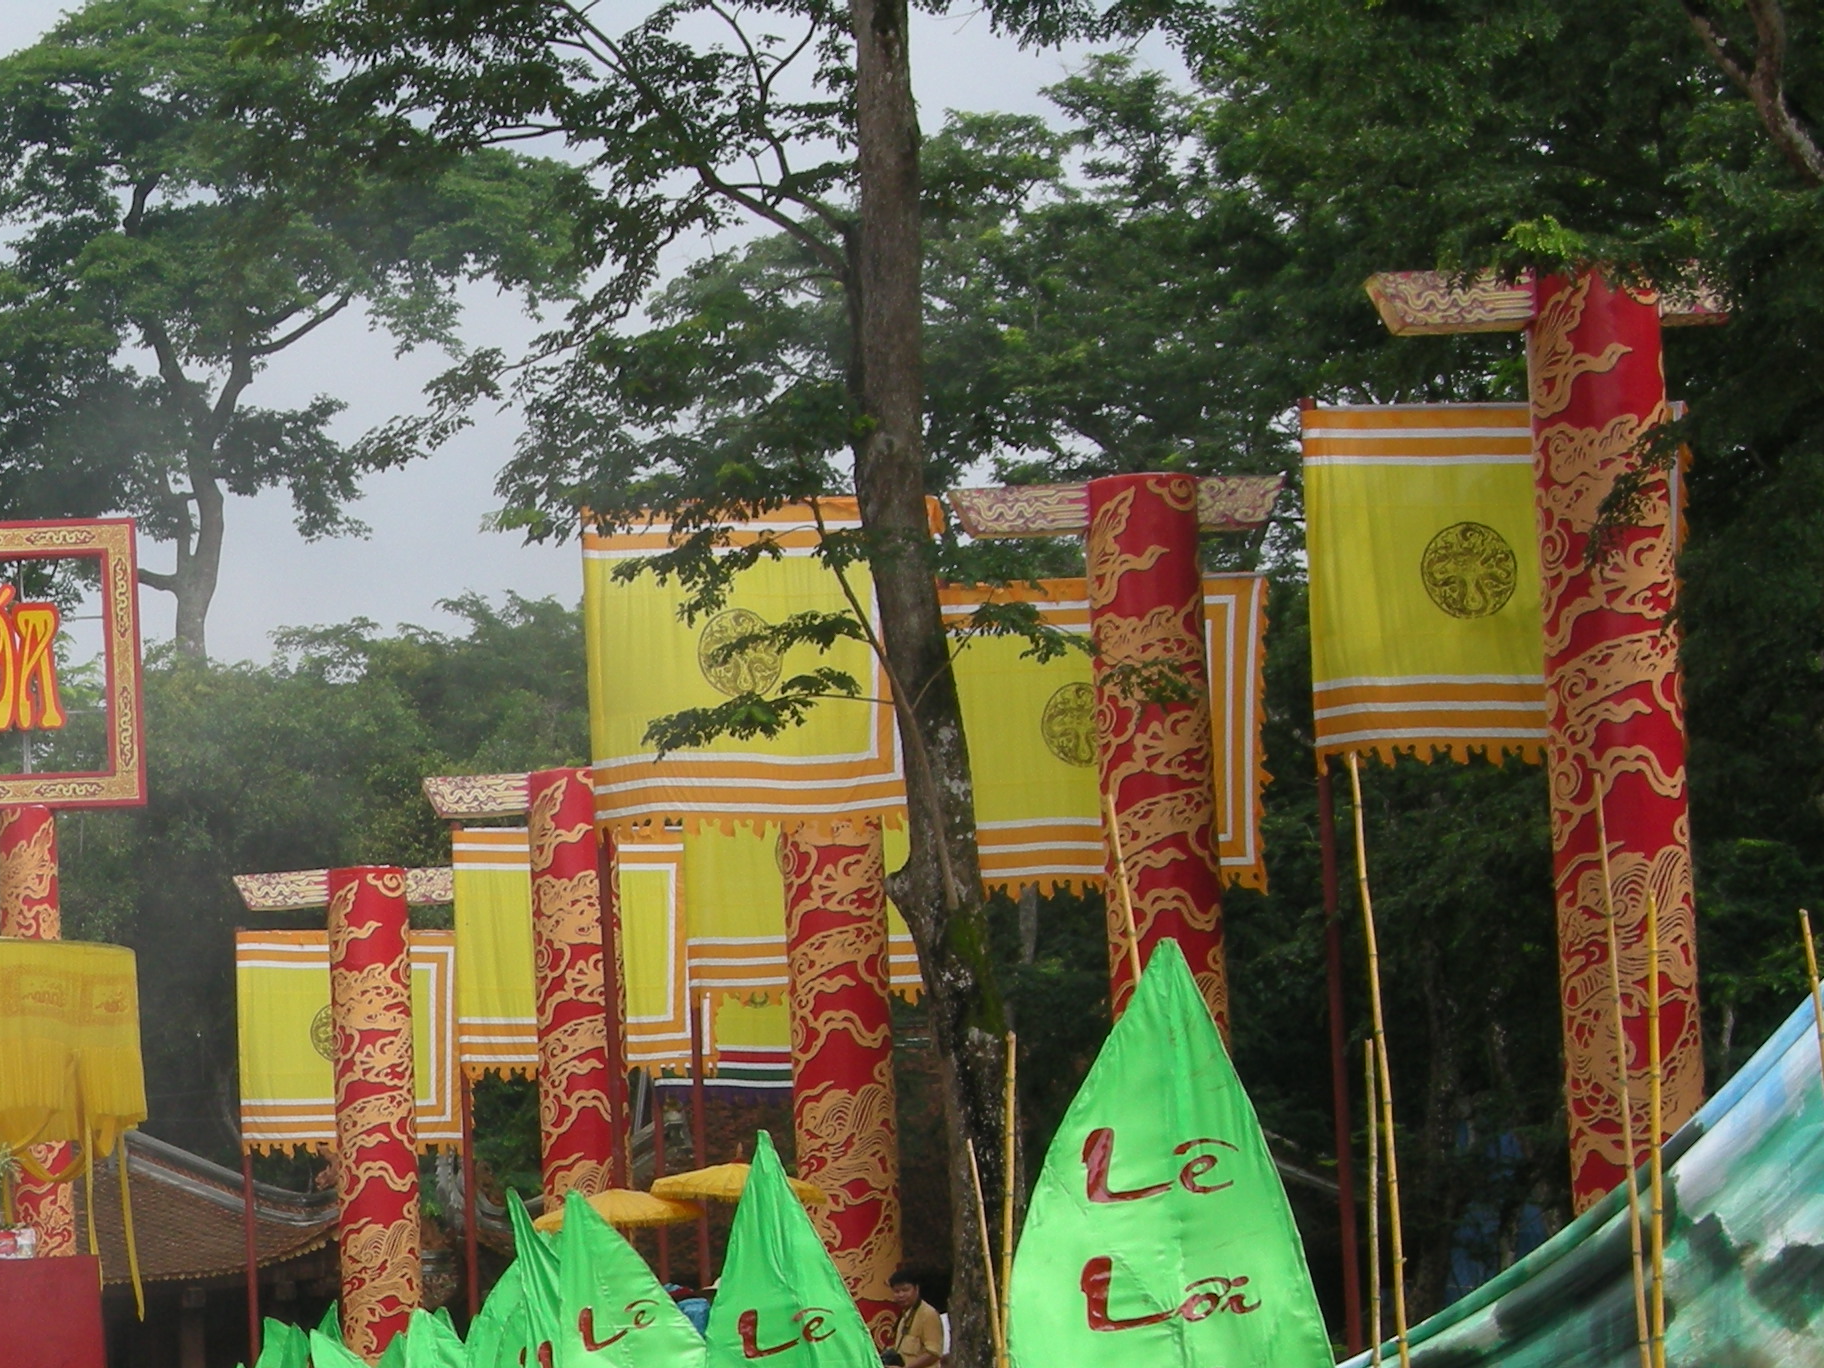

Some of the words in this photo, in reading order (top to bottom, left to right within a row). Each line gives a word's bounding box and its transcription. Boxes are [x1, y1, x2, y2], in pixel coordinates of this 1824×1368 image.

[1080, 1126, 1240, 1205] Lê
[578, 1299, 660, 1352] Lê
[738, 1307, 837, 1359] Lê
